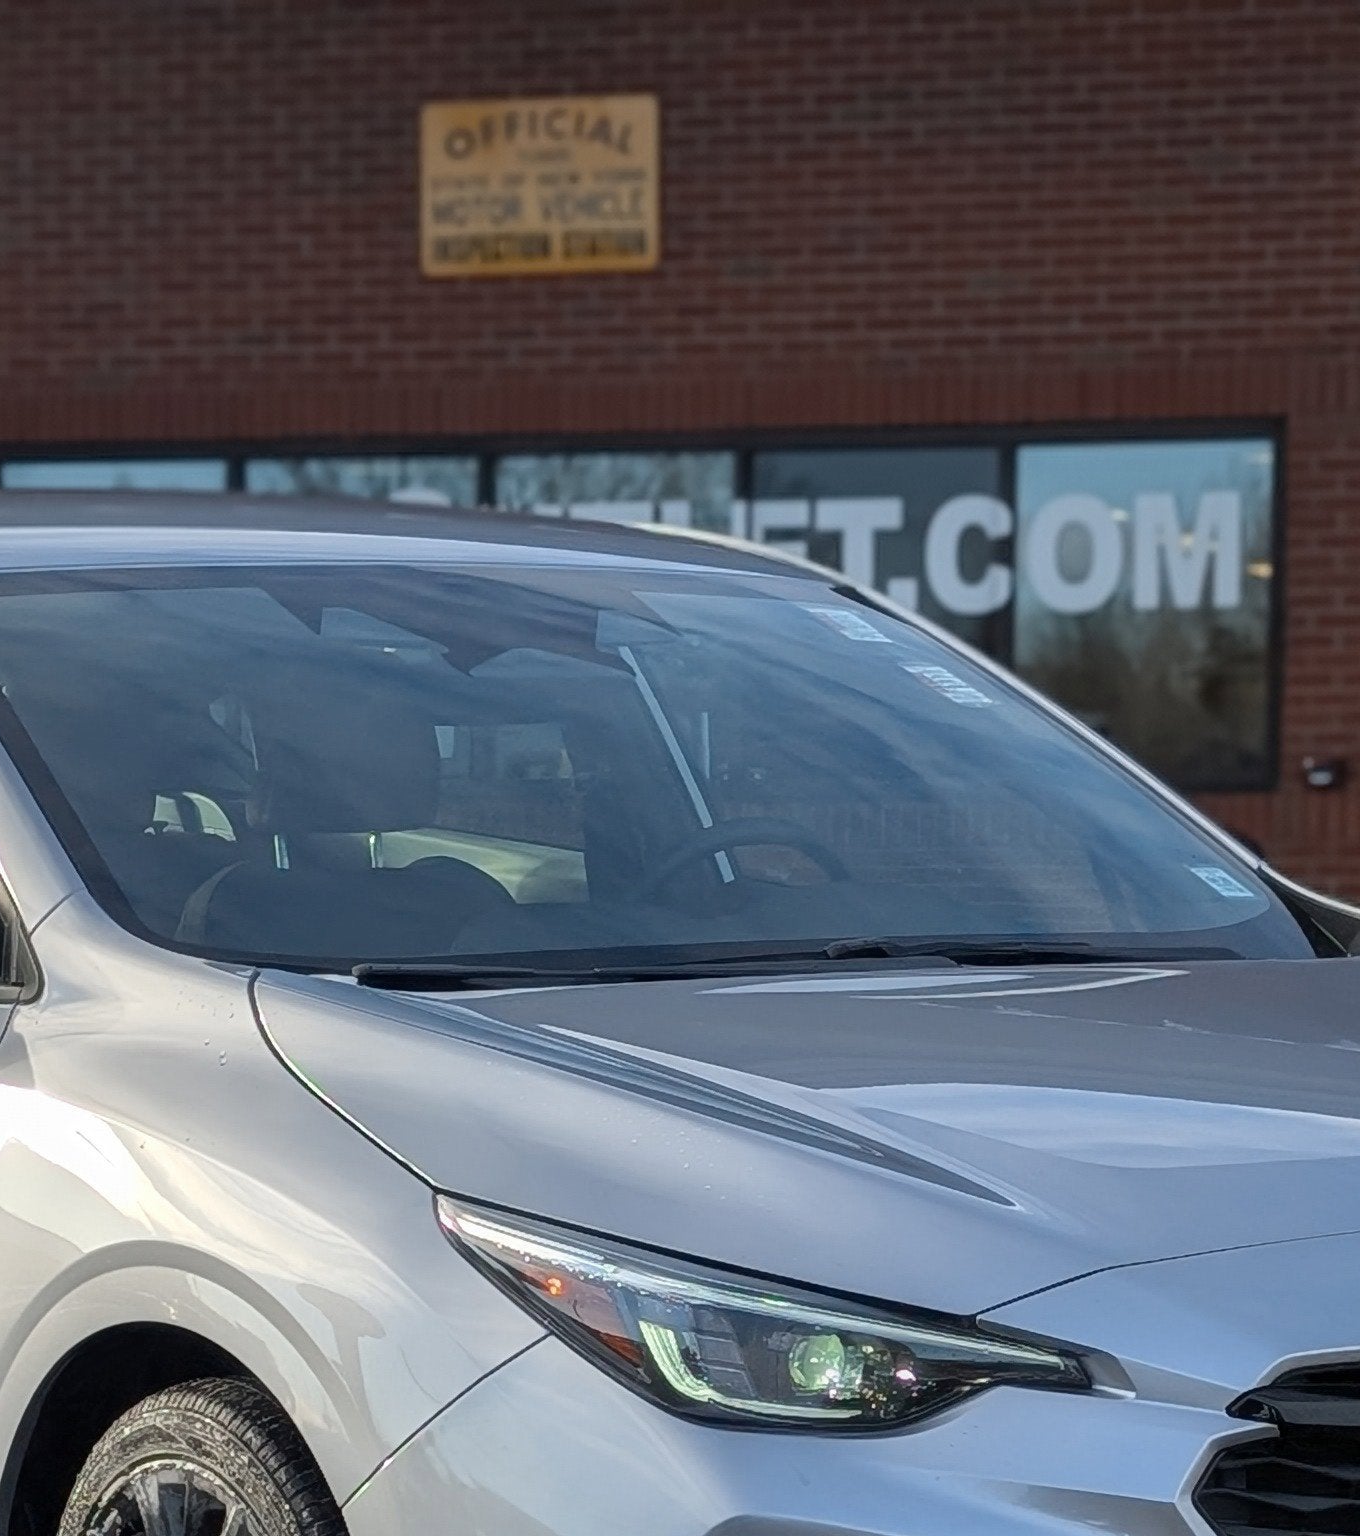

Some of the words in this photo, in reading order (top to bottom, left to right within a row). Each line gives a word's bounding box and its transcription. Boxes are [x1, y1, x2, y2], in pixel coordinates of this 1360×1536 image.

[443, 105, 633, 160] OFFICIAL
[431, 195, 521, 226] MOTOR
[537, 188, 645, 224] VEHICLE
